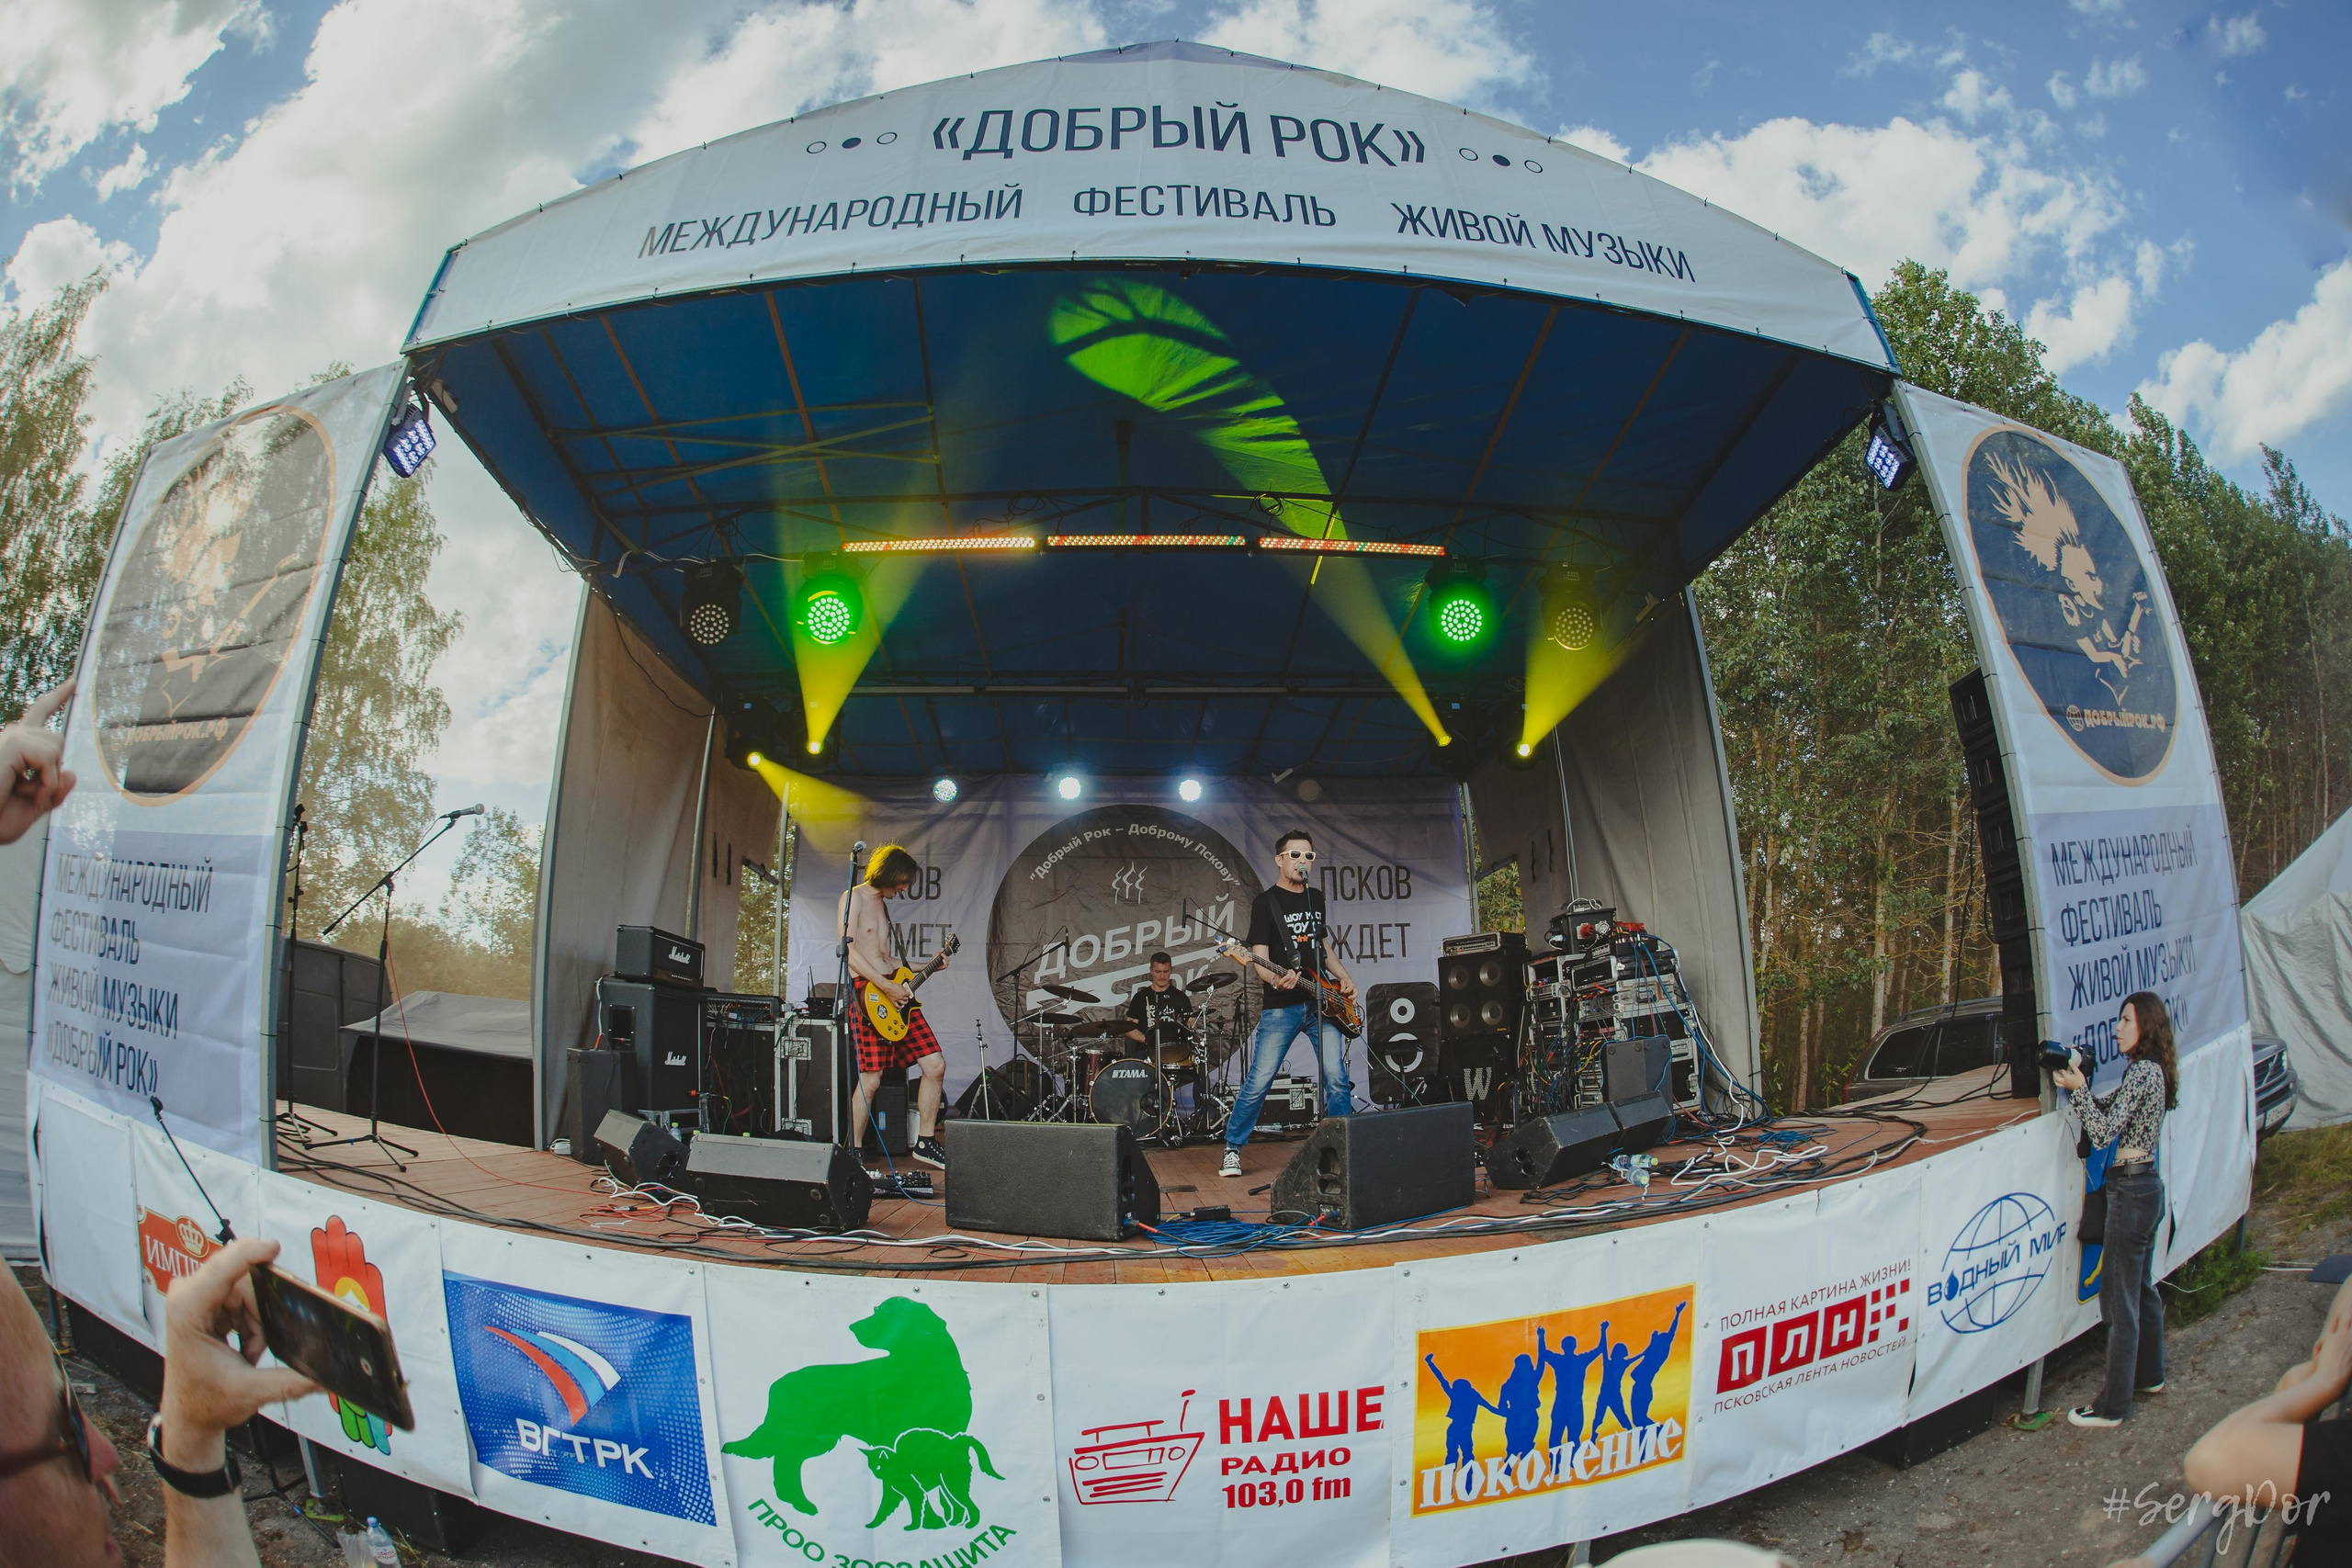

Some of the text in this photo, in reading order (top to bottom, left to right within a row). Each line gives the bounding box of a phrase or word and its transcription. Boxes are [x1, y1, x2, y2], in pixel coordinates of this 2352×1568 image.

[933, 101, 1425, 166] «ДОБРЫЙ РОК»
[638, 184, 1696, 283] МЕЖДУНАРОДНЫЙ ФЕСТИВАЛЬ ЖИВОЙ МУЗЫКИ
[1084, 828, 1112, 841] Рок
[1128, 824, 1193, 848] Доброму
[2051, 823, 2198, 886] МЕЖДУНАРОДНЫЙ
[55, 852, 213, 913] МЕЖДУНАРОДНЫЙ
[1320, 865, 1411, 901] ПСКОВ
[51, 908, 140, 965] ФЕСТИВАЛЬ
[888, 922, 952, 958] МЕТ
[1034, 893, 1235, 984] ДОБРЫЙ
[1326, 922, 1410, 964] ЖДЕТ
[2061, 889, 2162, 947] ФЕСТИВАЛЬ
[48, 961, 178, 1039] ЖИВОЙ МУЗЫКИ
[2068, 935, 2196, 1010] ЖИВОЙ МУЗЫКИ
[47, 1021, 158, 1095] «ДОБРЫЙ РОК»
[2030, 1222, 2066, 1258] МИР
[1721, 1258, 1911, 1332] ПОЛНАЯ КАРТИНА ЖИЗНИ!
[1713, 1336, 1906, 1414] ПСКОВСКАЯ ЛЕНТА НОВОСТЕЙ
[1218, 1385, 1385, 1445] НАШЕ
[515, 1417, 655, 1480] ВГТРК
[1221, 1447, 1351, 1476] РАДИО
[1222, 1476, 1351, 1509] 103,0 fm
[747, 1498, 825, 1562] ПРОО
